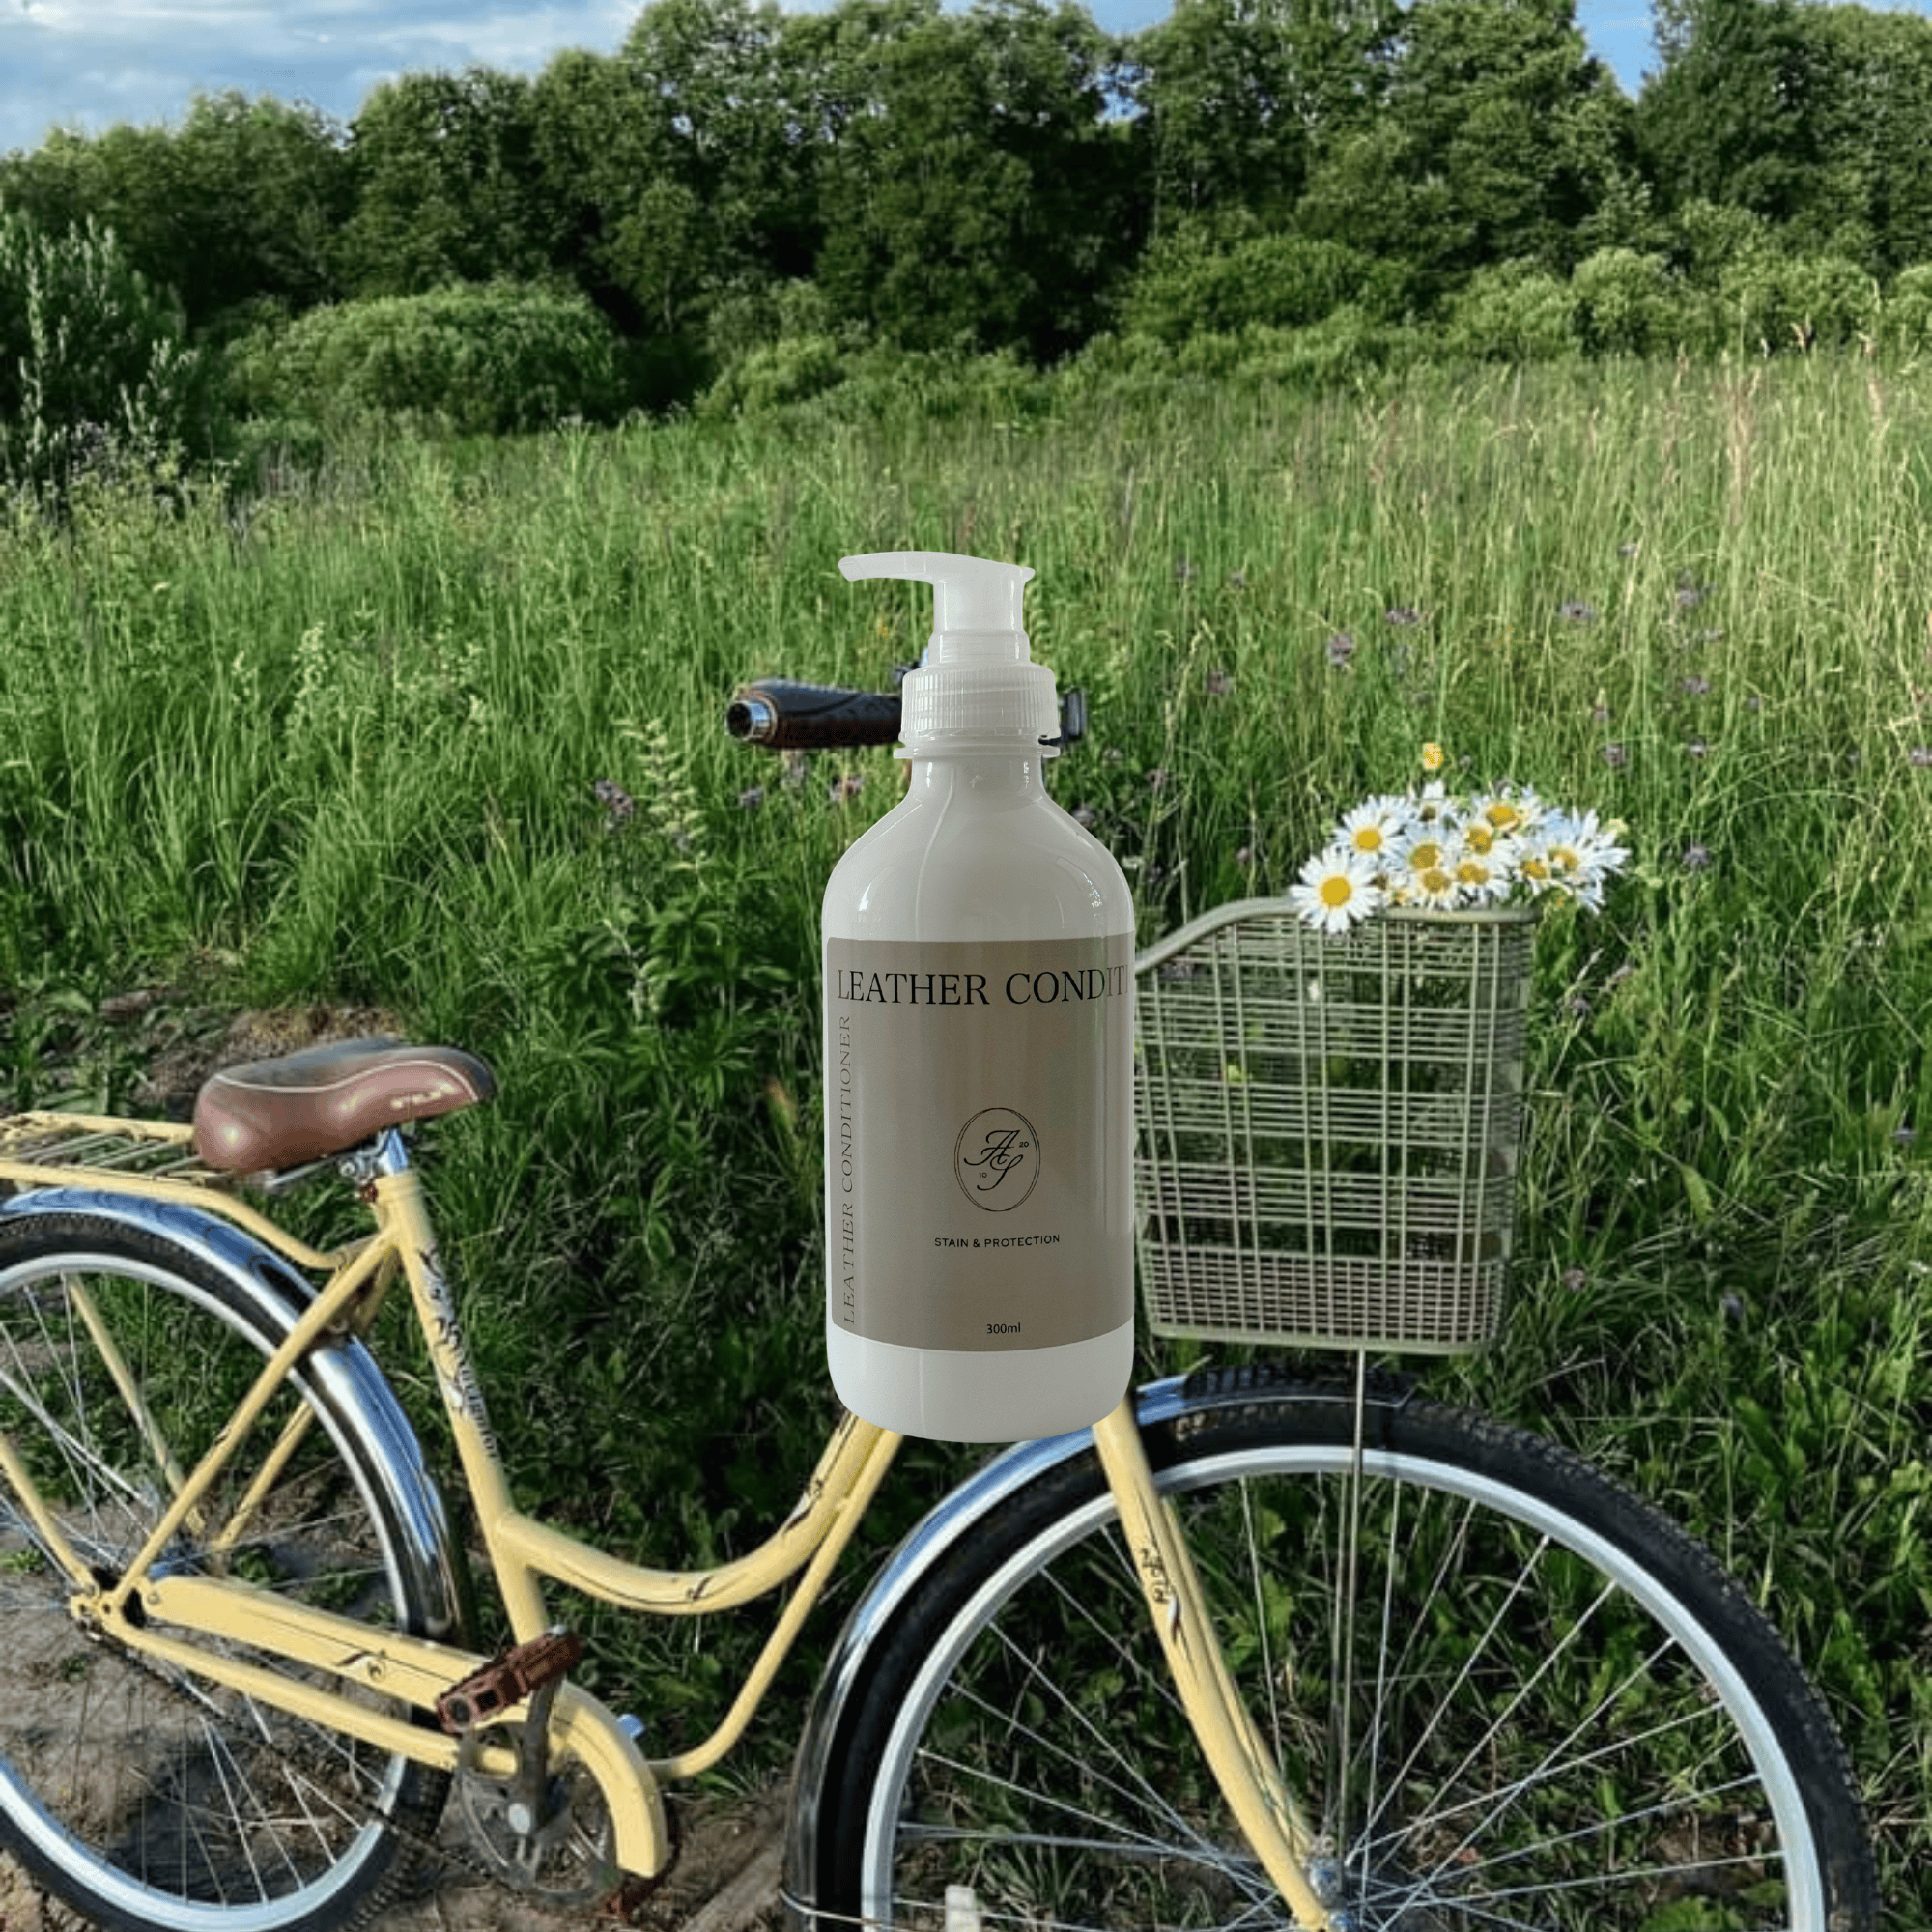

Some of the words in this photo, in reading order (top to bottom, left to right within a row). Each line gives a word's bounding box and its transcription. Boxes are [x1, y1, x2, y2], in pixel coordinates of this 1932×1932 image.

[838, 969, 990, 1005] LEATHER
[839, 1016, 853, 1193] CONDITIONER
[934, 1237, 969, 1248] STAIN
[973, 1238, 980, 1248] &
[984, 1234, 1060, 1248] PROTECTION
[843, 1203, 855, 1324] LEATHER
[986, 1322, 1021, 1334] 300ml
